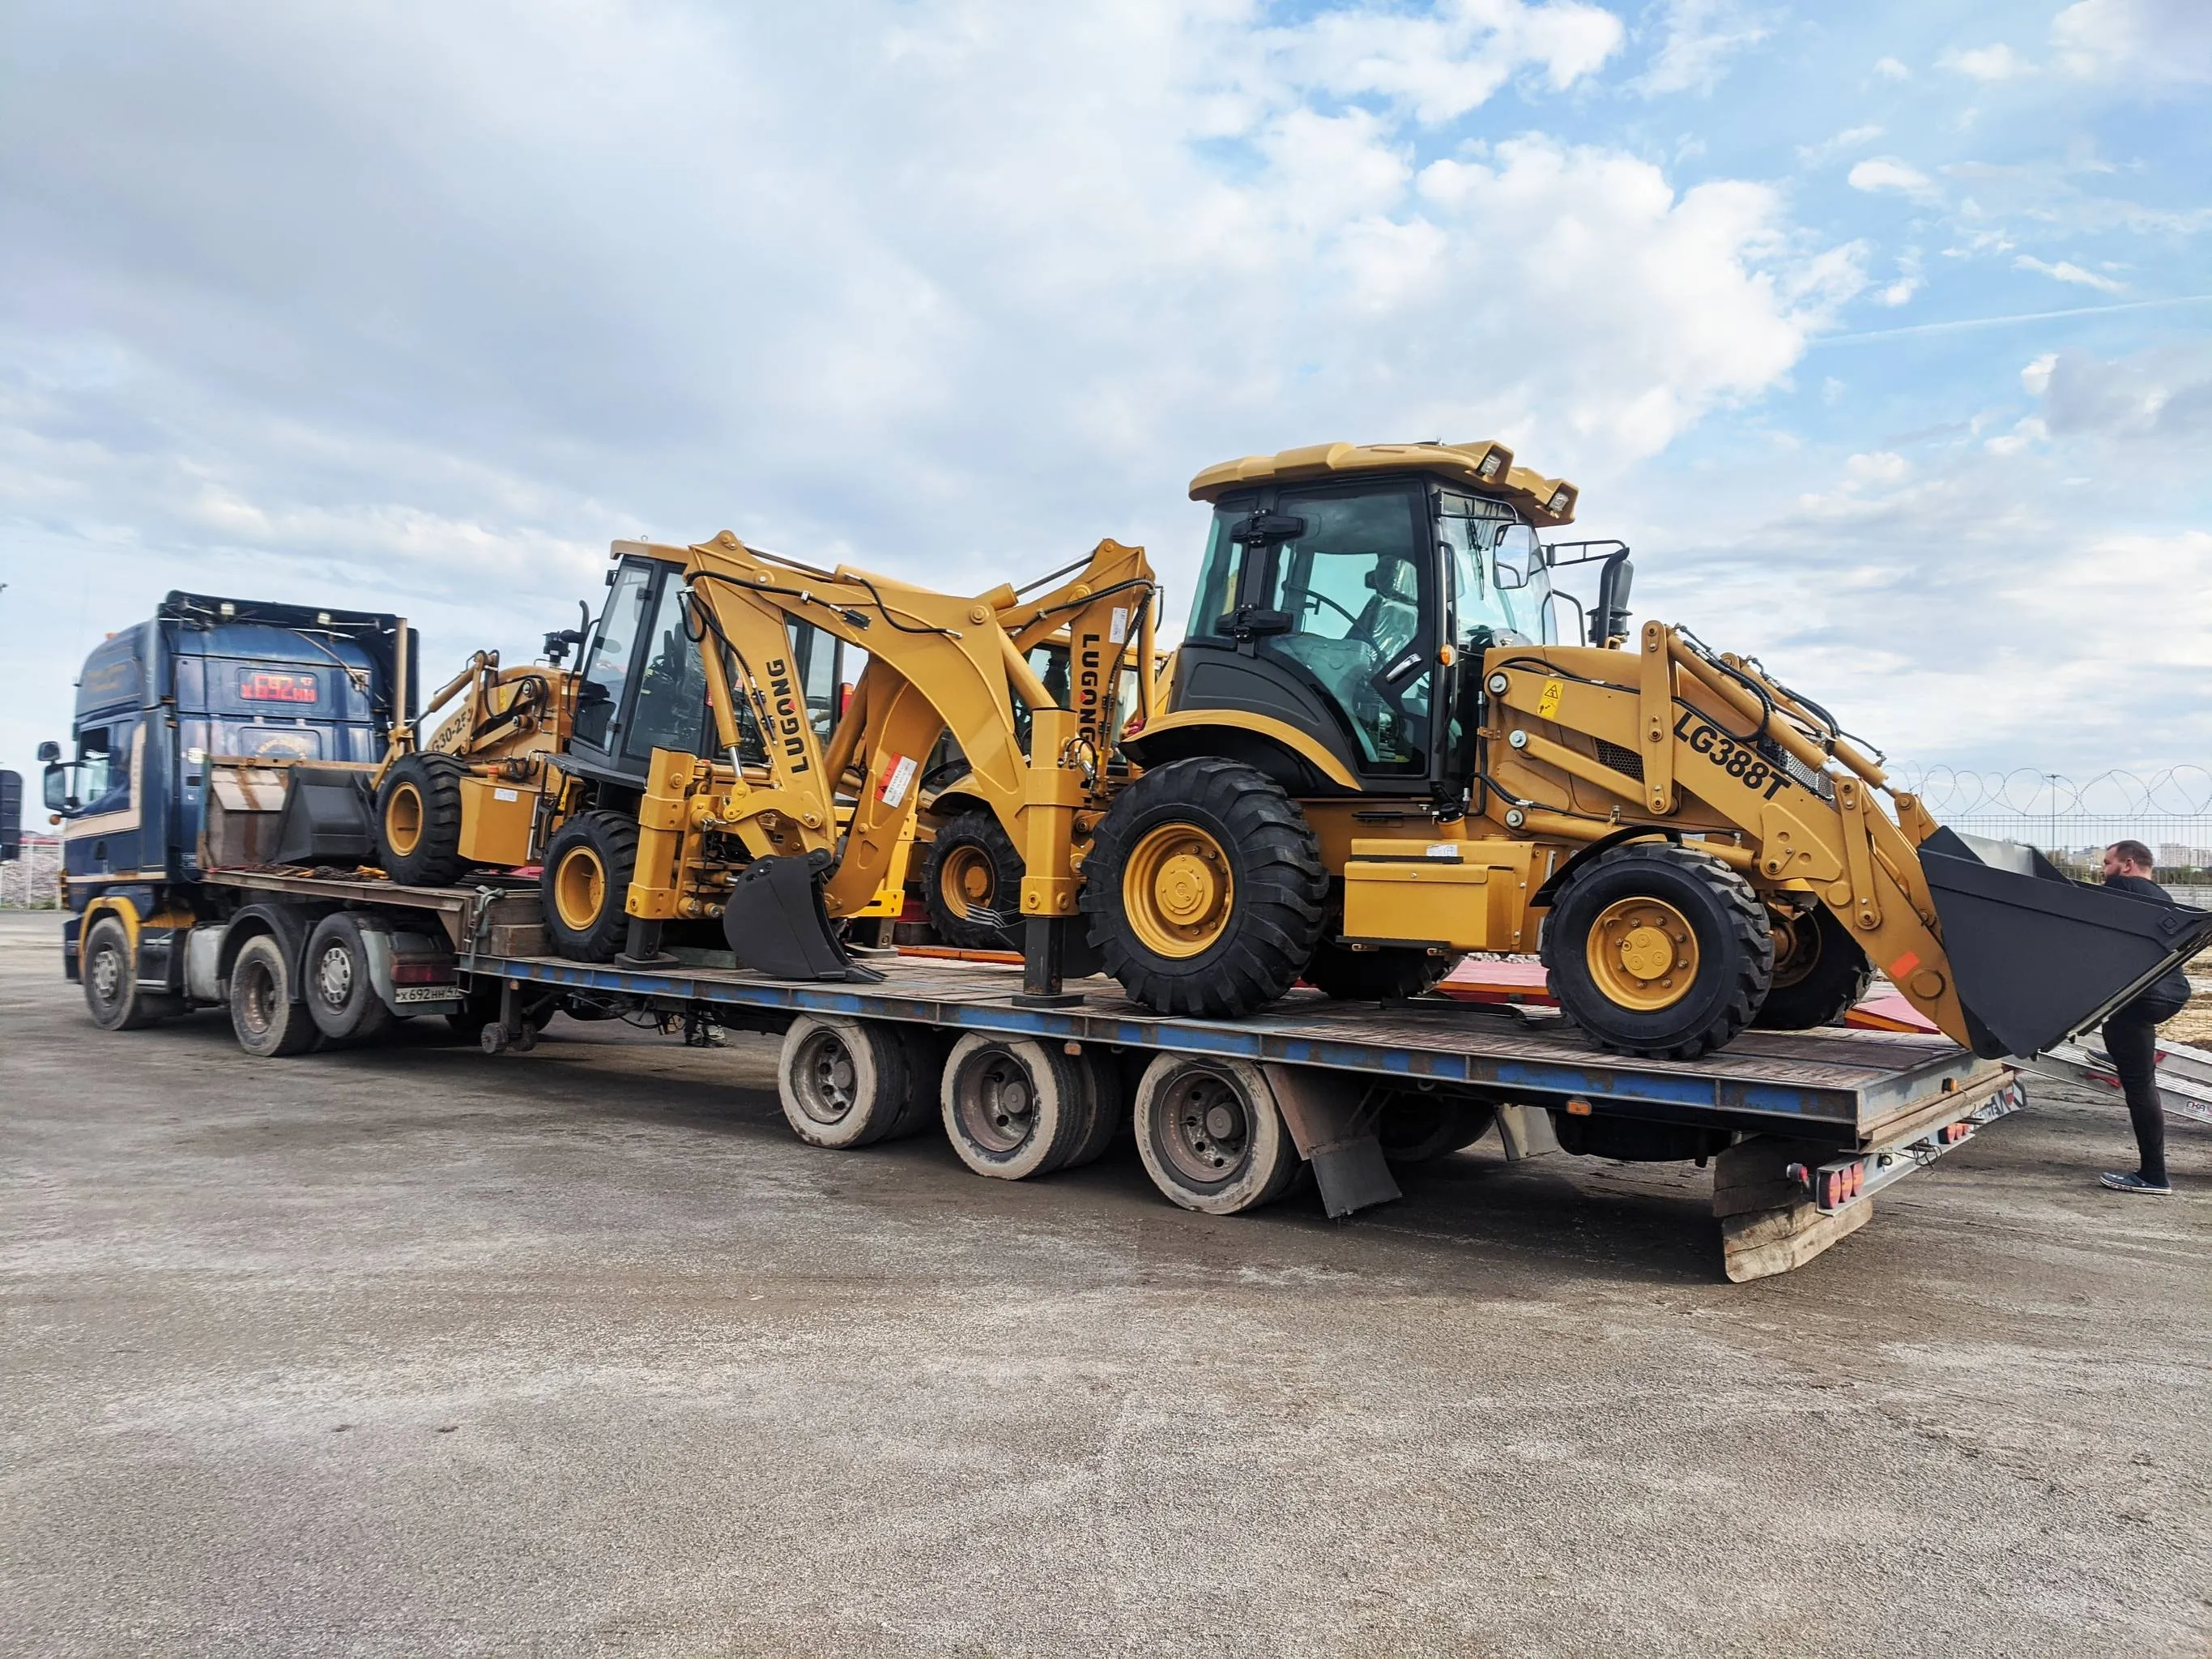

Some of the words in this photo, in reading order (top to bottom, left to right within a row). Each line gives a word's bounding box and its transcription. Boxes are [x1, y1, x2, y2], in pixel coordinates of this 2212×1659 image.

[766, 659, 809, 774] LUGONG
[1080, 634, 1100, 744] LUGONG
[1673, 711, 1792, 801] LG388T
